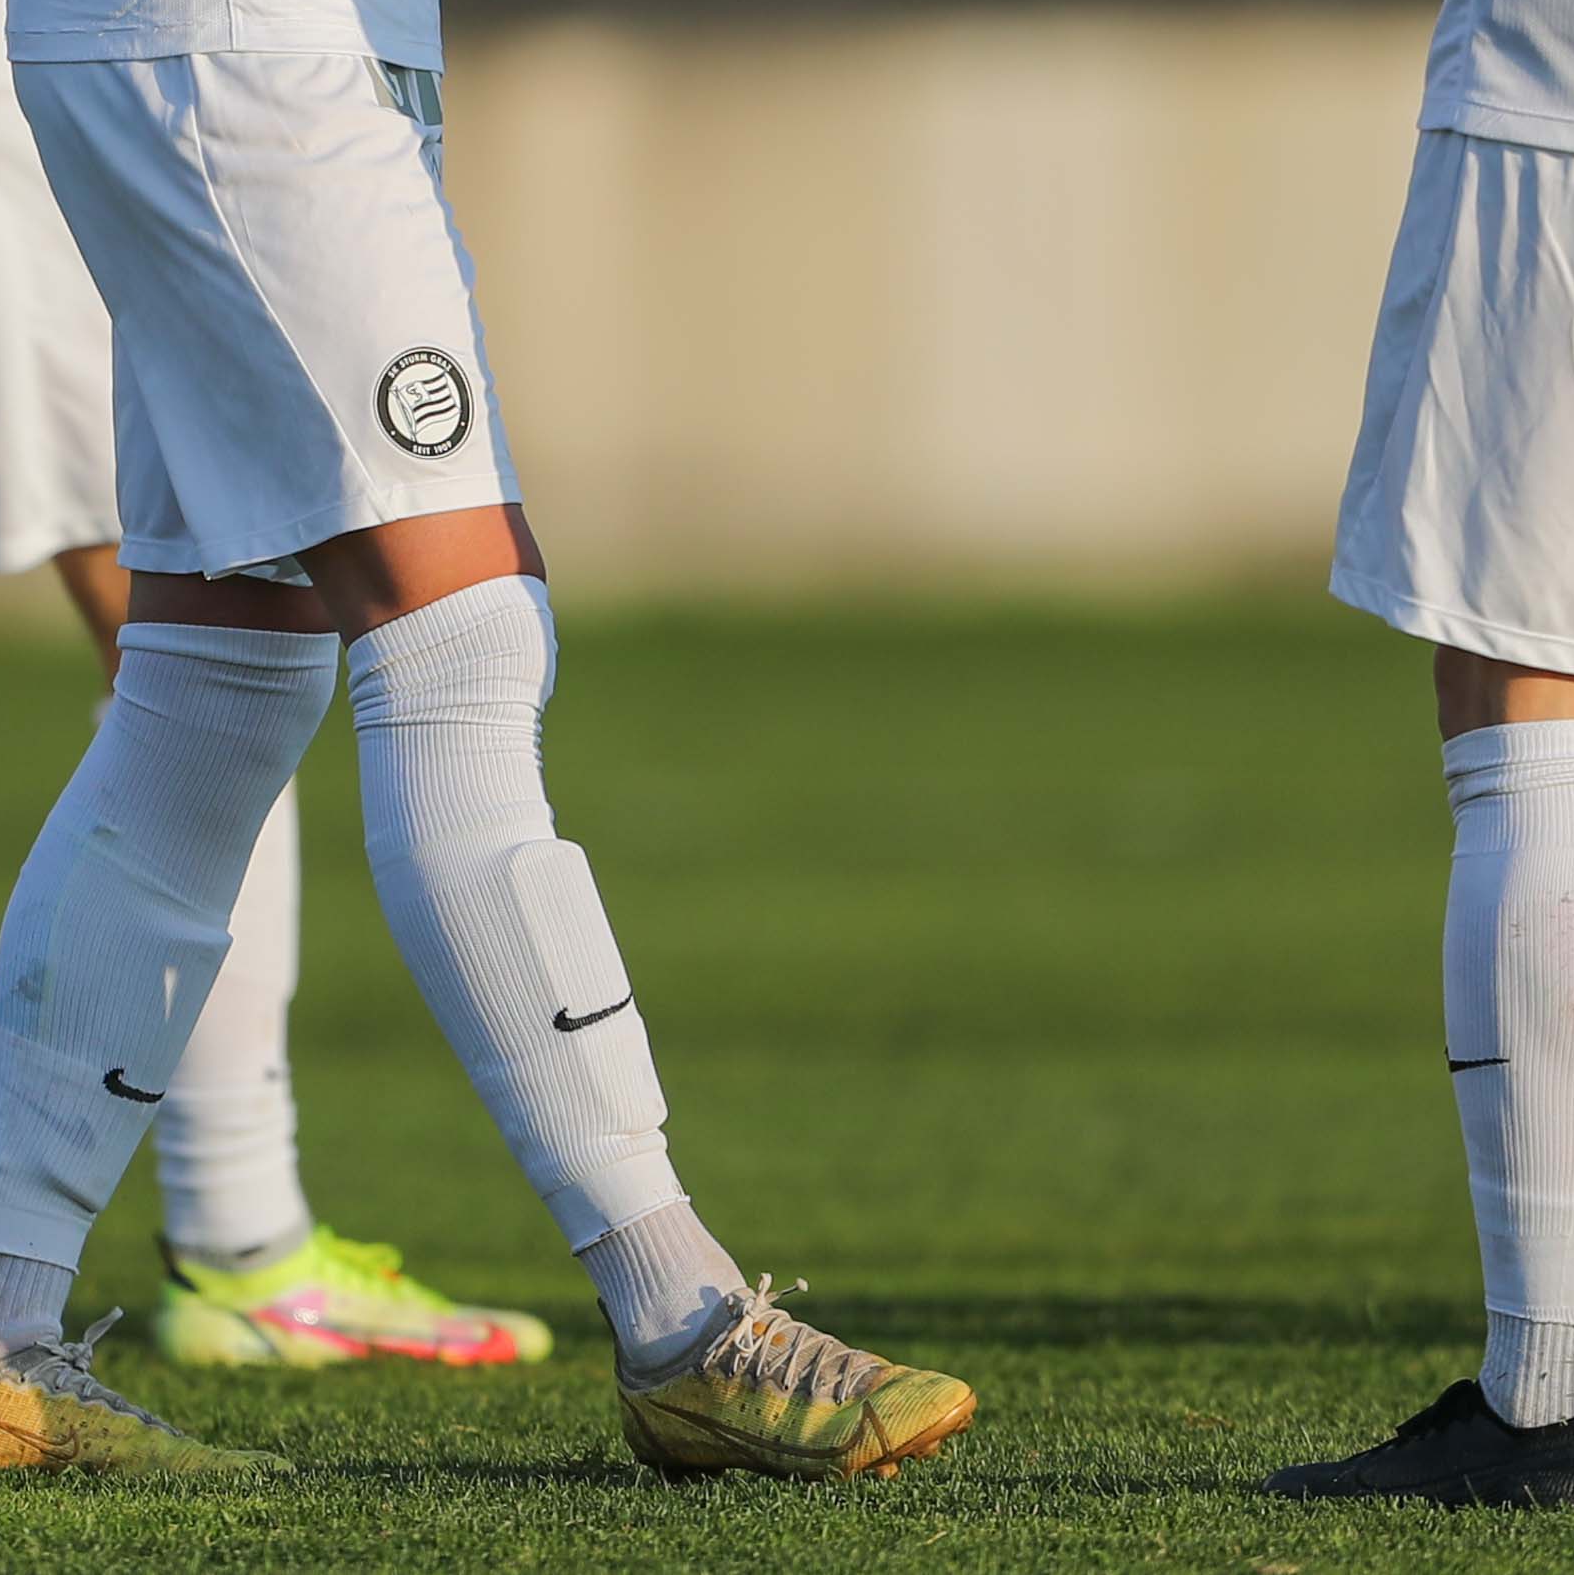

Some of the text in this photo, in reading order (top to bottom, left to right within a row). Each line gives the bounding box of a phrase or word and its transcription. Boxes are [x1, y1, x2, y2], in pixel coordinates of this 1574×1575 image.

[388, 353, 452, 379] SK STURM GRAZ
